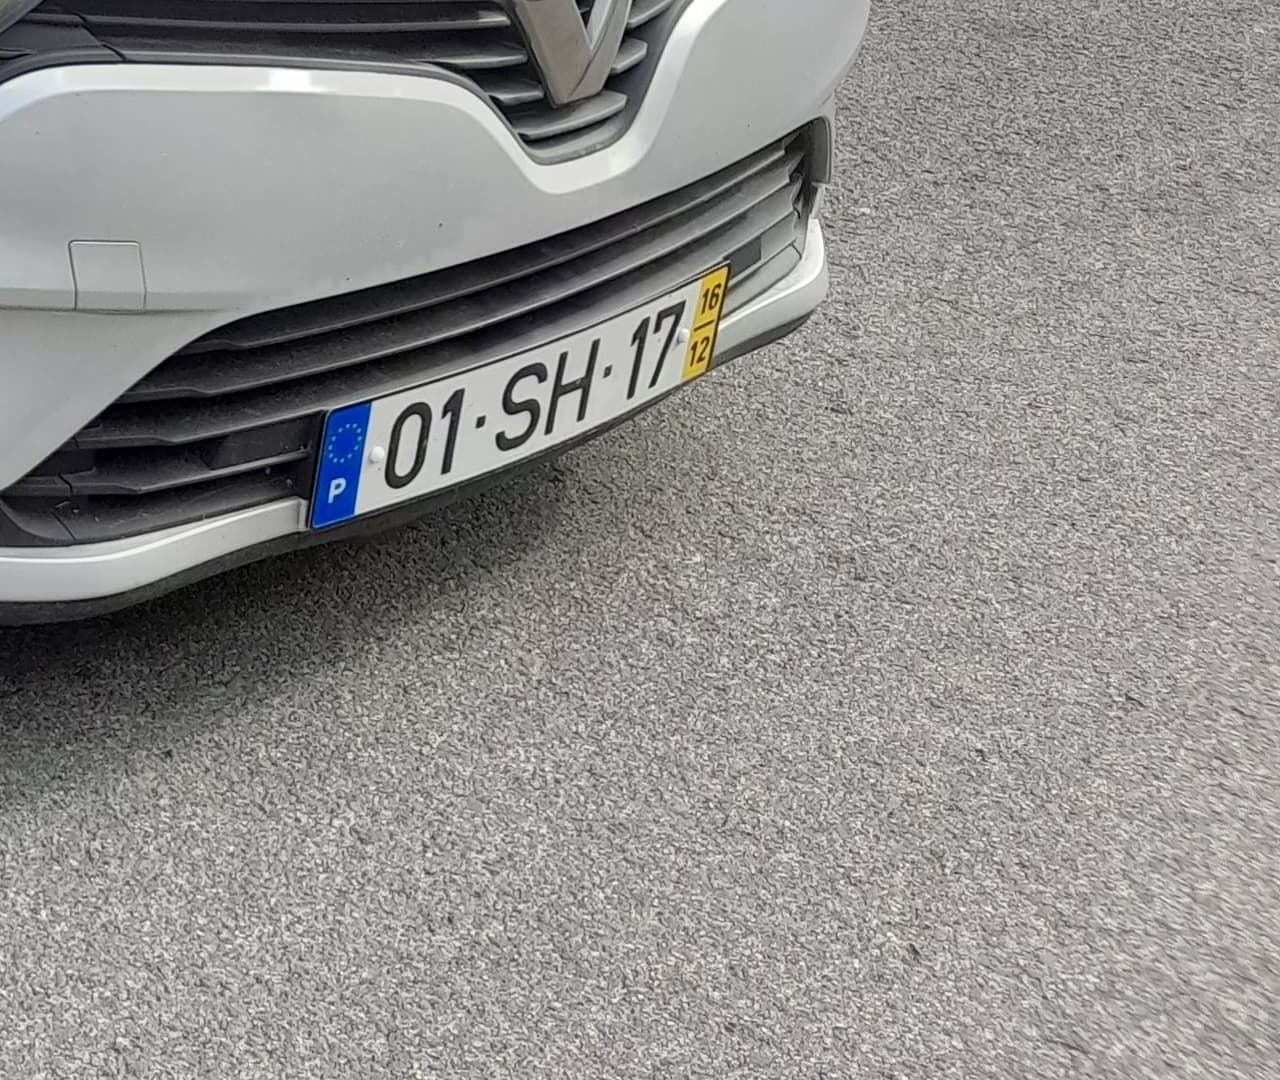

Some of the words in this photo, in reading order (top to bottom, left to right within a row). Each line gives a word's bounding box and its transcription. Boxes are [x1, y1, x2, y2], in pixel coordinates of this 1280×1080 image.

[700, 282, 721, 315] 16
[689, 335, 709, 368] 12
[327, 477, 347, 504] P
